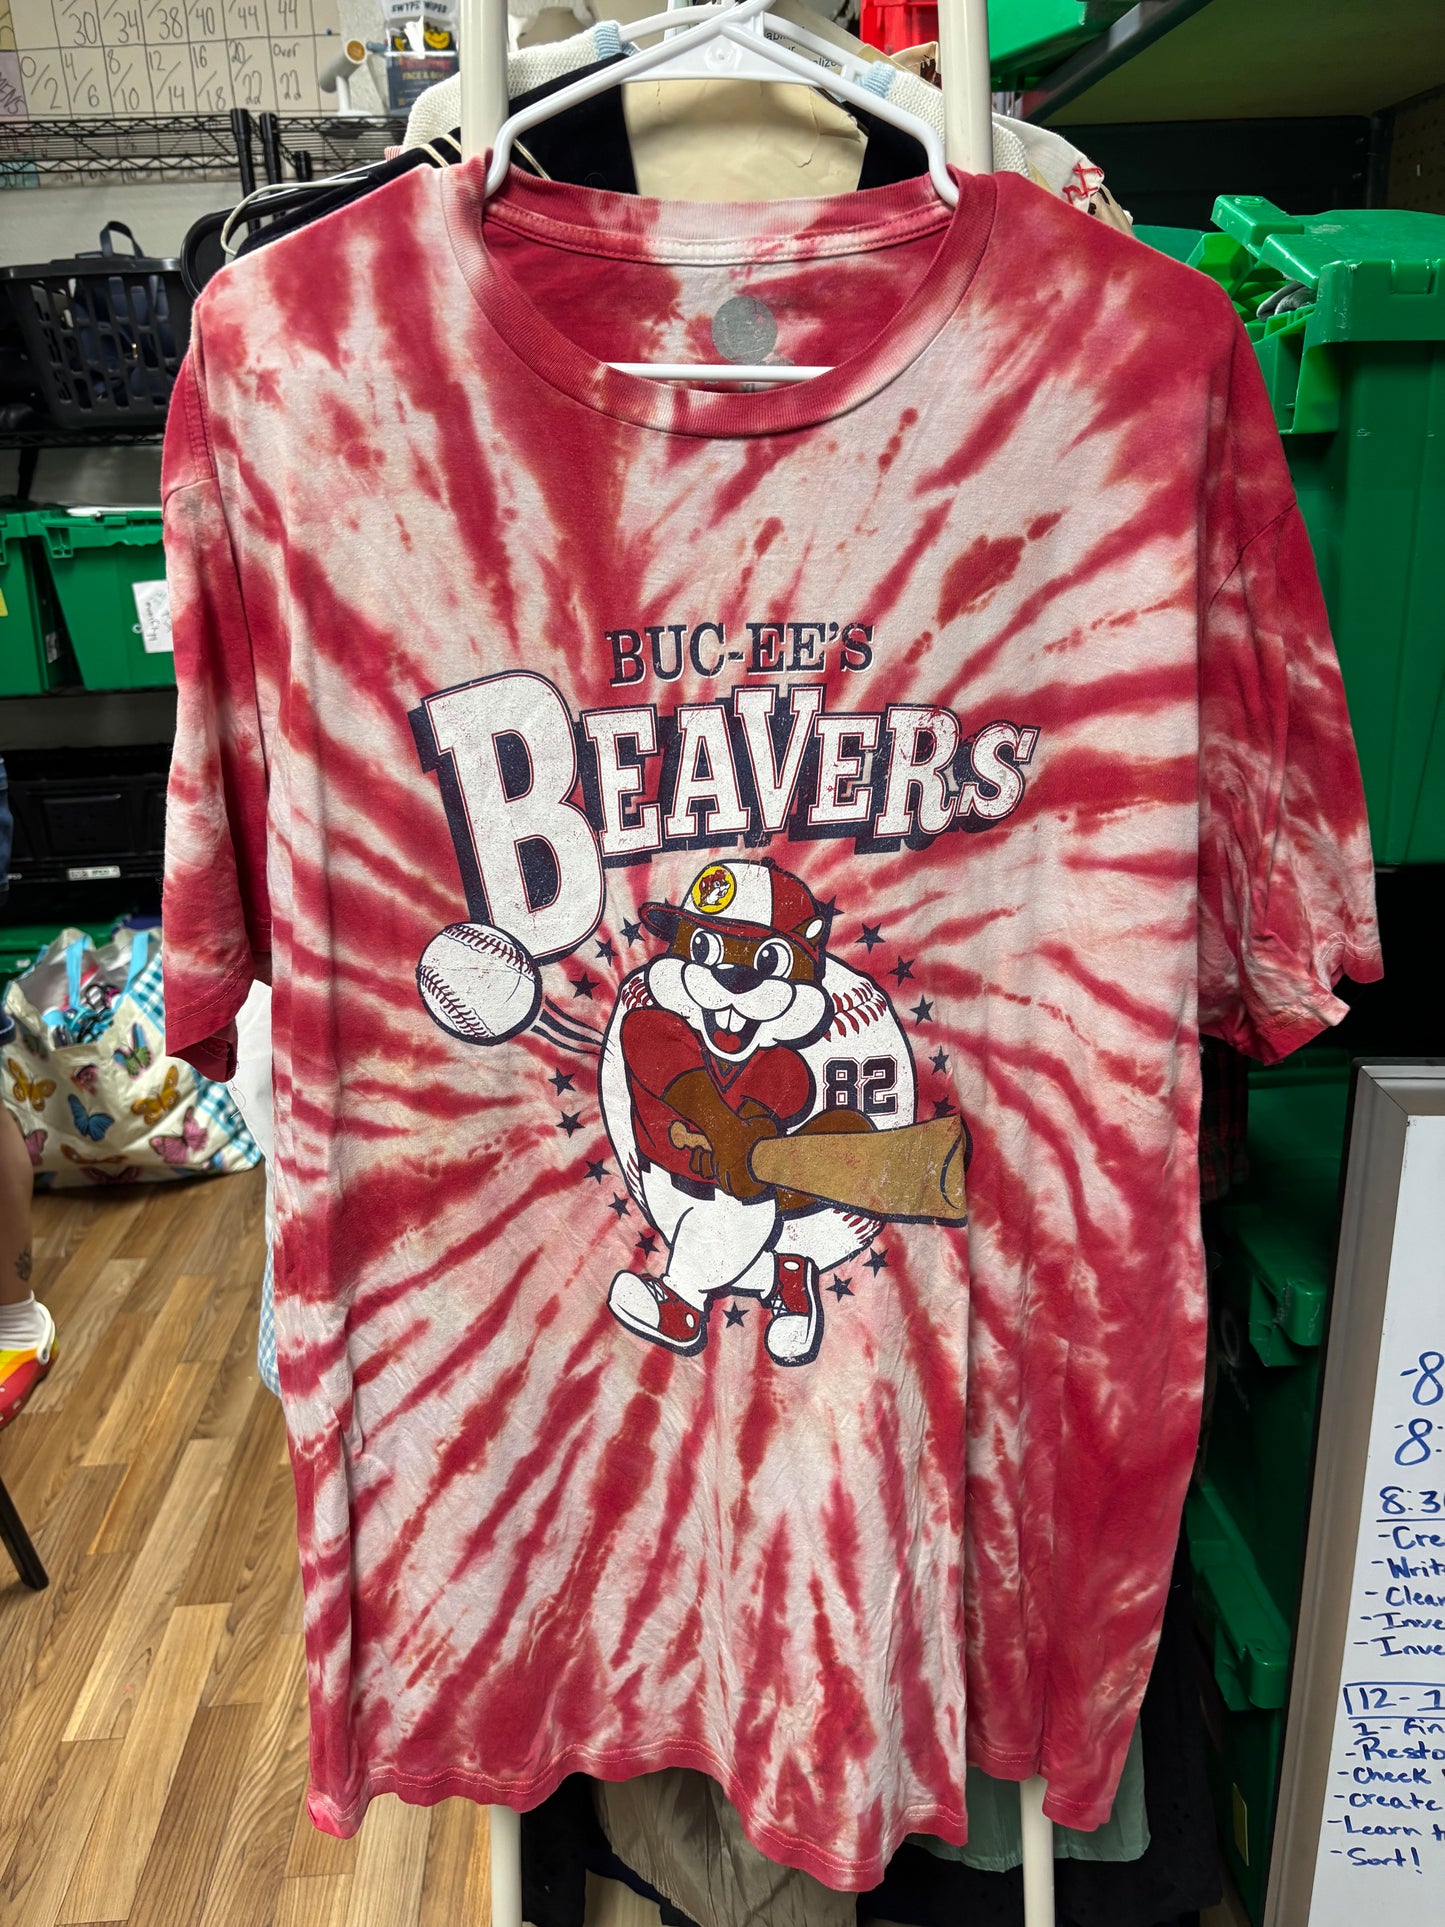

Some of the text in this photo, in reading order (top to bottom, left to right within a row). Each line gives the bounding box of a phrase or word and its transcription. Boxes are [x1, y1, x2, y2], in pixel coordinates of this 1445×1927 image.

[605, 622, 874, 687] BUC-EE'S
[412, 669, 1042, 960] BEAVERS
[823, 1055, 898, 1116] 82
[1379, 1486, 1445, 1515] 8:3
